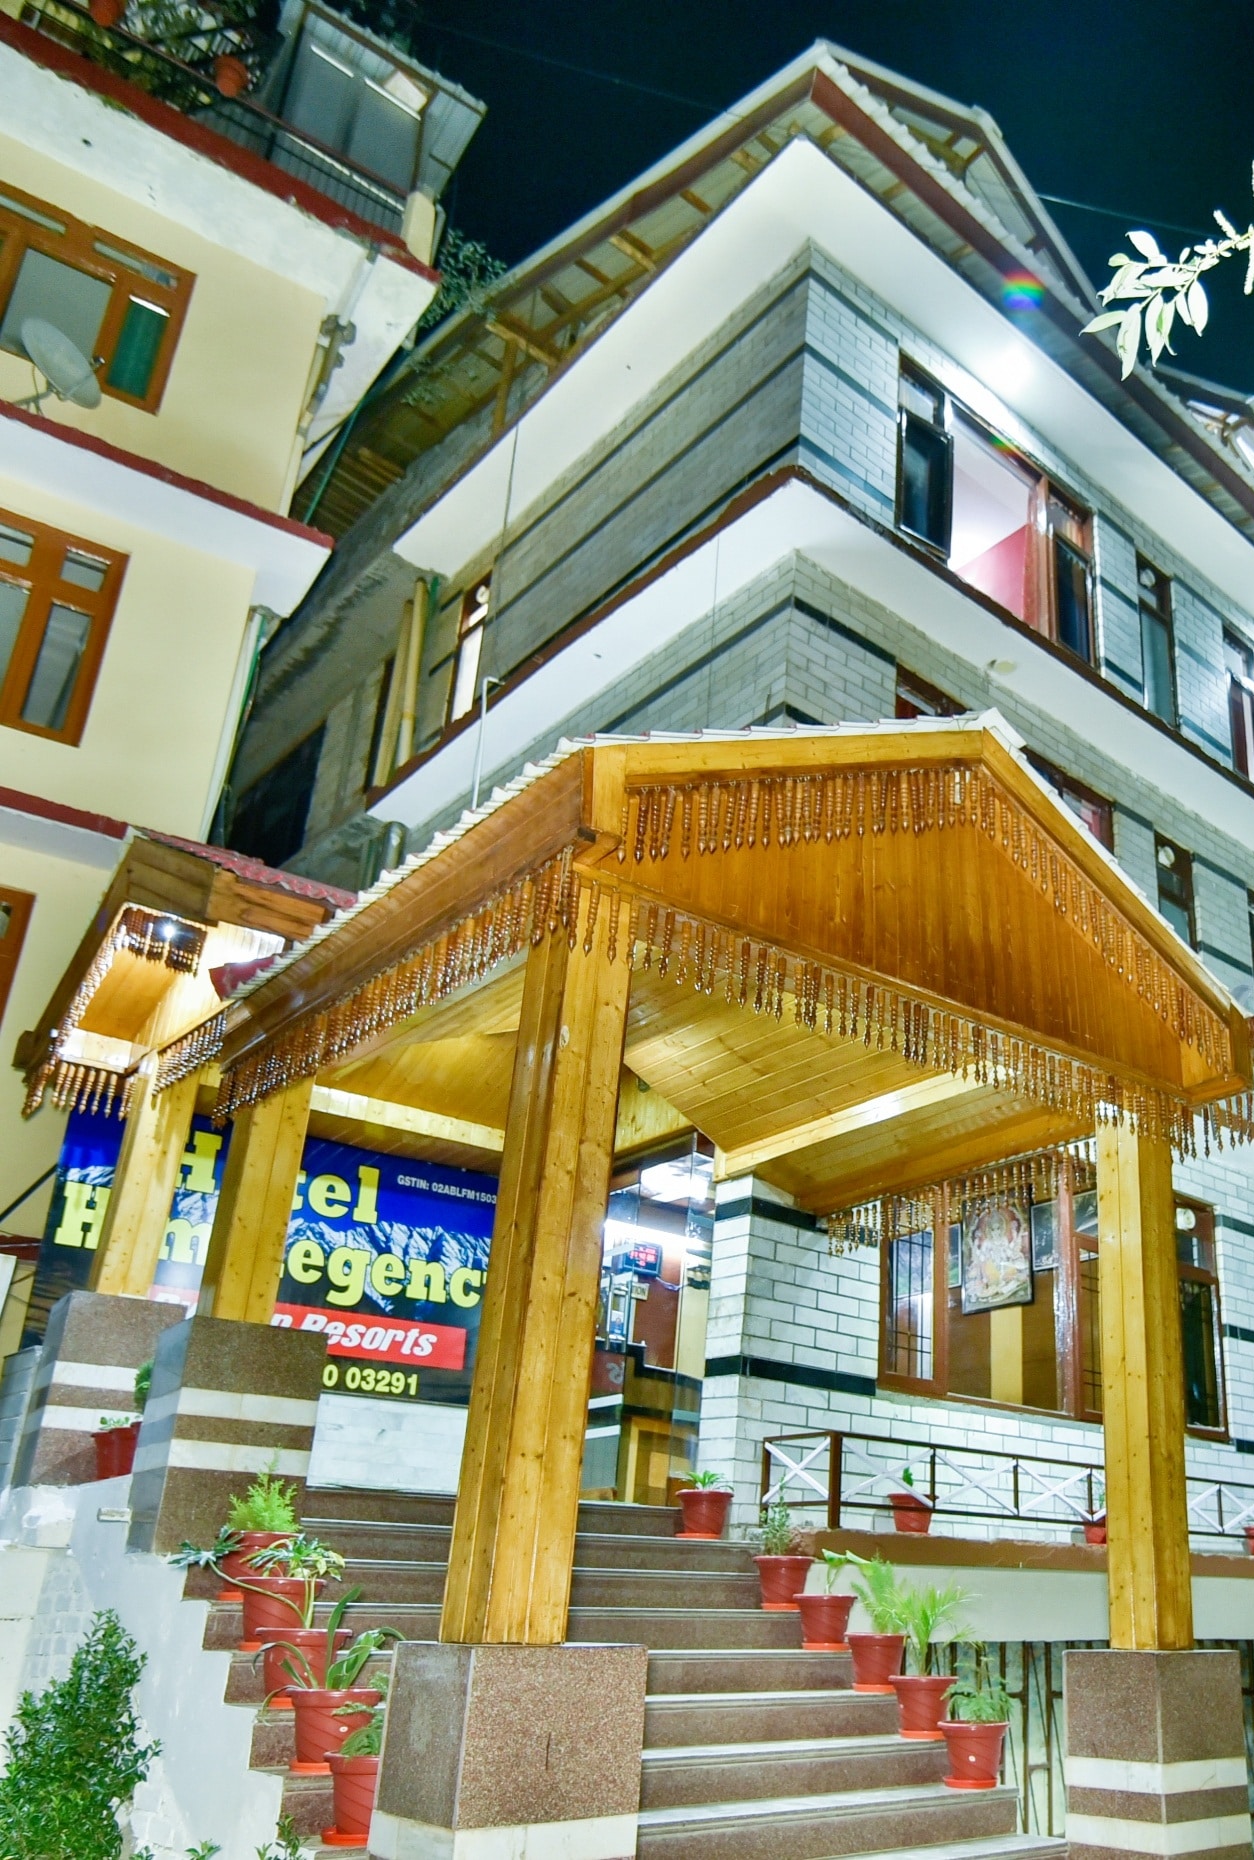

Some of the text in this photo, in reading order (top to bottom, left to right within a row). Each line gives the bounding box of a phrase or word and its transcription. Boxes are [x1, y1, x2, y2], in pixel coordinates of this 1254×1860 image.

[176, 1130, 380, 1225] Hel
[397, 1175, 430, 1190] GSTIN:
[280, 1240, 487, 1308] egenc
[301, 1314, 438, 1356] Resorts
[346, 1366, 418, 1396] 03291
